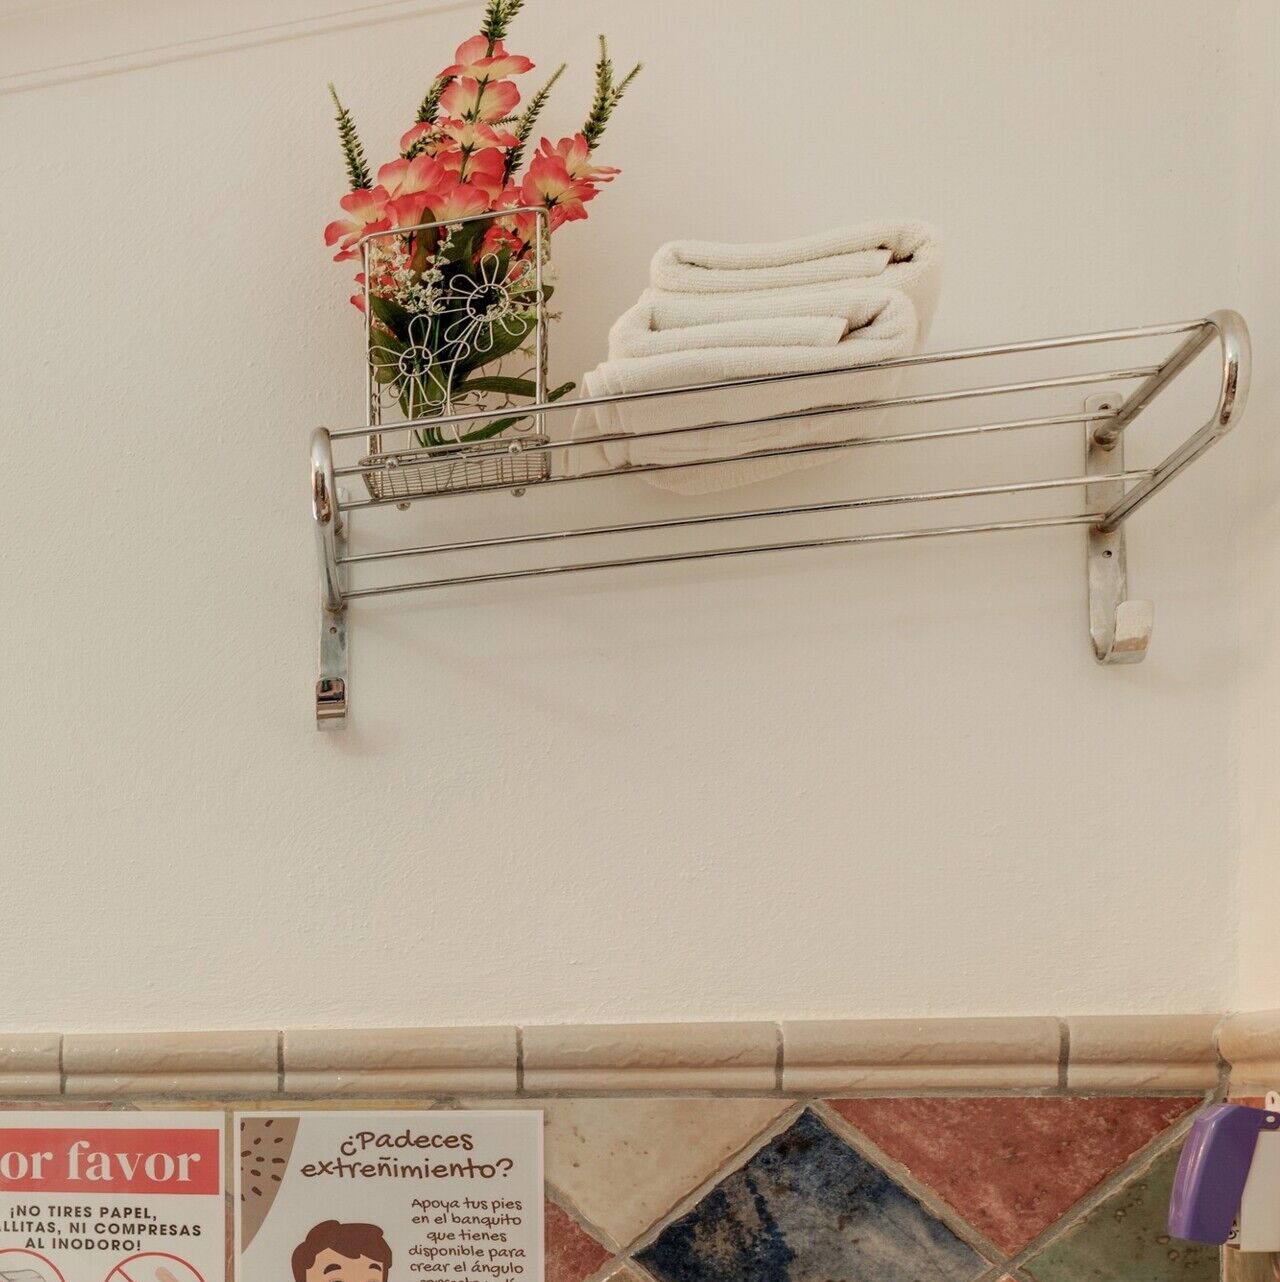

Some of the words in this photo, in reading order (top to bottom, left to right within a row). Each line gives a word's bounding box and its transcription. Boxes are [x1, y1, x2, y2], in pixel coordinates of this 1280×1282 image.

[340, 1129, 474, 1156] ¿Padeces
[67, 1140, 201, 1182] favor
[301, 1156, 514, 1179] extreñimiento?
[10, 1205, 41, 1219] ¡NO
[48, 1206, 92, 1218] TIRES
[99, 1207, 157, 1221] PAPEL,
[411, 1199, 460, 1213] Apoya
[463, 1197, 488, 1210] tus
[491, 1198, 522, 1213] pies
[412, 1216, 429, 1224] en
[434, 1213, 447, 1224] el
[451, 1213, 522, 1229] banquito
[69, 1222, 87, 1234] NI
[94, 1222, 202, 1237] COMPRESAS
[427, 1231, 455, 1244] que
[459, 1229, 507, 1242] tienes
[25, 1237, 44, 1249] AL
[52, 1238, 141, 1251] INODORO!
[409, 1245, 484, 1260] disponible
[489, 1248, 526, 1261] para
[410, 1262, 450, 1273] crear
[454, 1261, 466, 1272] el
[471, 1261, 524, 1278] ángulo
